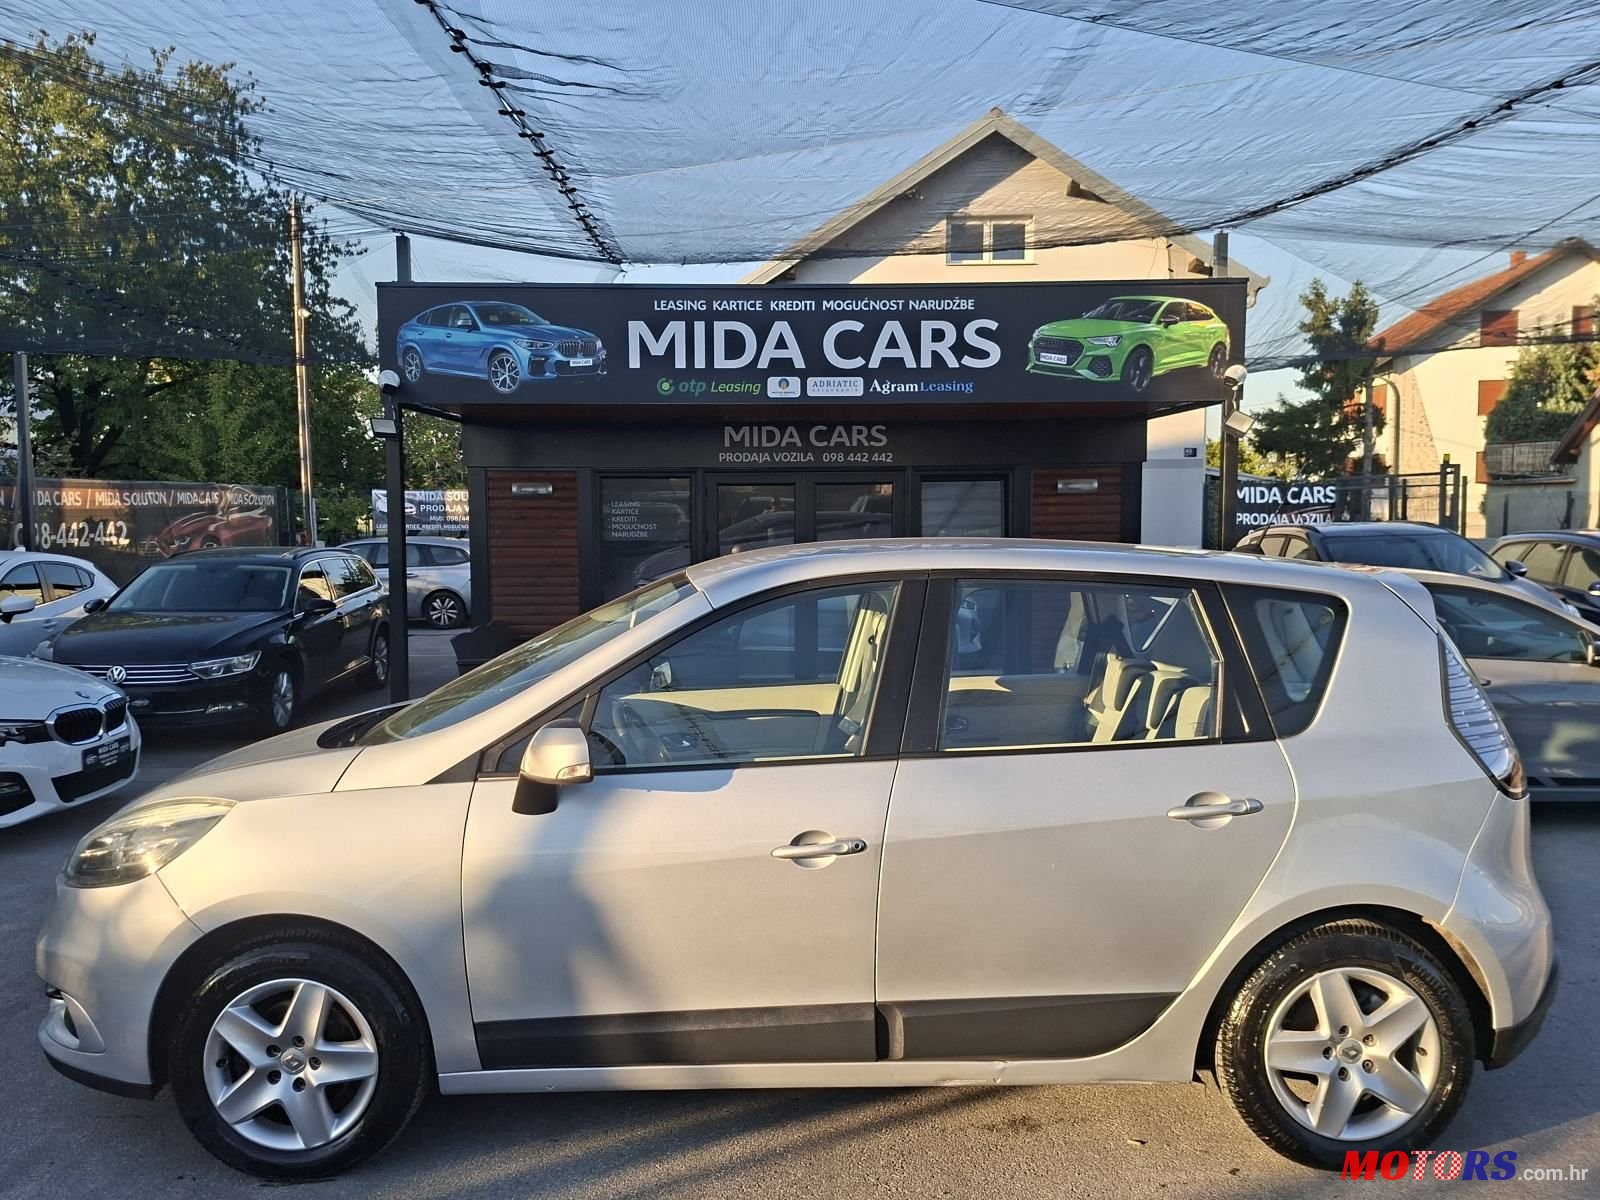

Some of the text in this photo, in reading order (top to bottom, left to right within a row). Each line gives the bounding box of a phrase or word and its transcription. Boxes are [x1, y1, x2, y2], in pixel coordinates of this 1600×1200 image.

[654, 296, 975, 311] LEASING KARTICE KREDITI MOGUĆNOST NARUDŽBE
[627, 318, 1002, 370] MIDA CARS
[678, 379, 761, 397] otp Leasing
[812, 380, 859, 388] ADRIATIC
[724, 425, 888, 447] MIDA CARS
[719, 452, 893, 463] PRODAJA VOZILA 098 442 442
[53, 490, 82, 506] CARS
[95, 490, 121, 506] MIDA
[177, 490, 199, 505] MIDA
[416, 490, 444, 501] MIDA
[1237, 486, 1337, 504] MIDA CARS
[420, 504, 462, 513] PRODAJA
